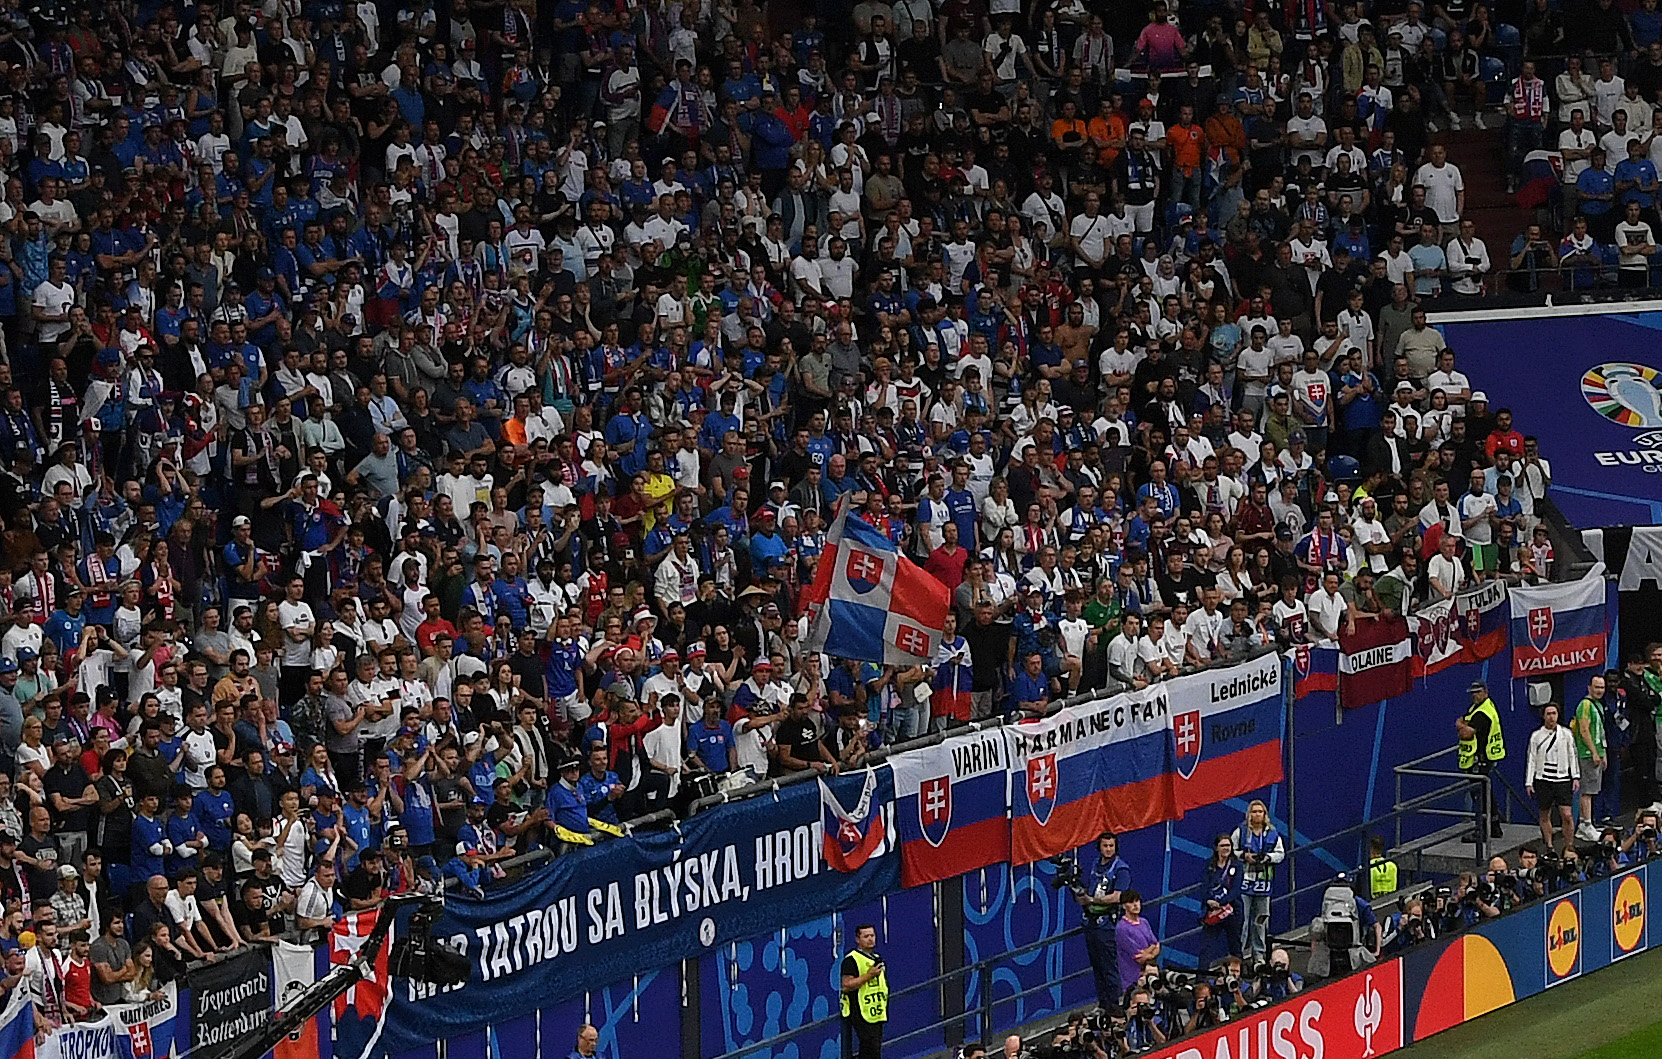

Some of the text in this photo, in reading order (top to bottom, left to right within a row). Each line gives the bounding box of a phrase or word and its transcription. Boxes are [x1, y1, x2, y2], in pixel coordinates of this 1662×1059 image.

[1351, 647, 1393, 671] OLAINE
[1518, 647, 1598, 671] VALALIKY
[1210, 664, 1277, 703] Lednické
[1016, 694, 1168, 757] HARMANEC FAN
[952, 733, 1000, 778] VARÍN
[1616, 900, 1643, 926] LIDL
[475, 896, 578, 981] TATROU
[587, 882, 625, 944] SA
[1549, 925, 1577, 951] LIDL
